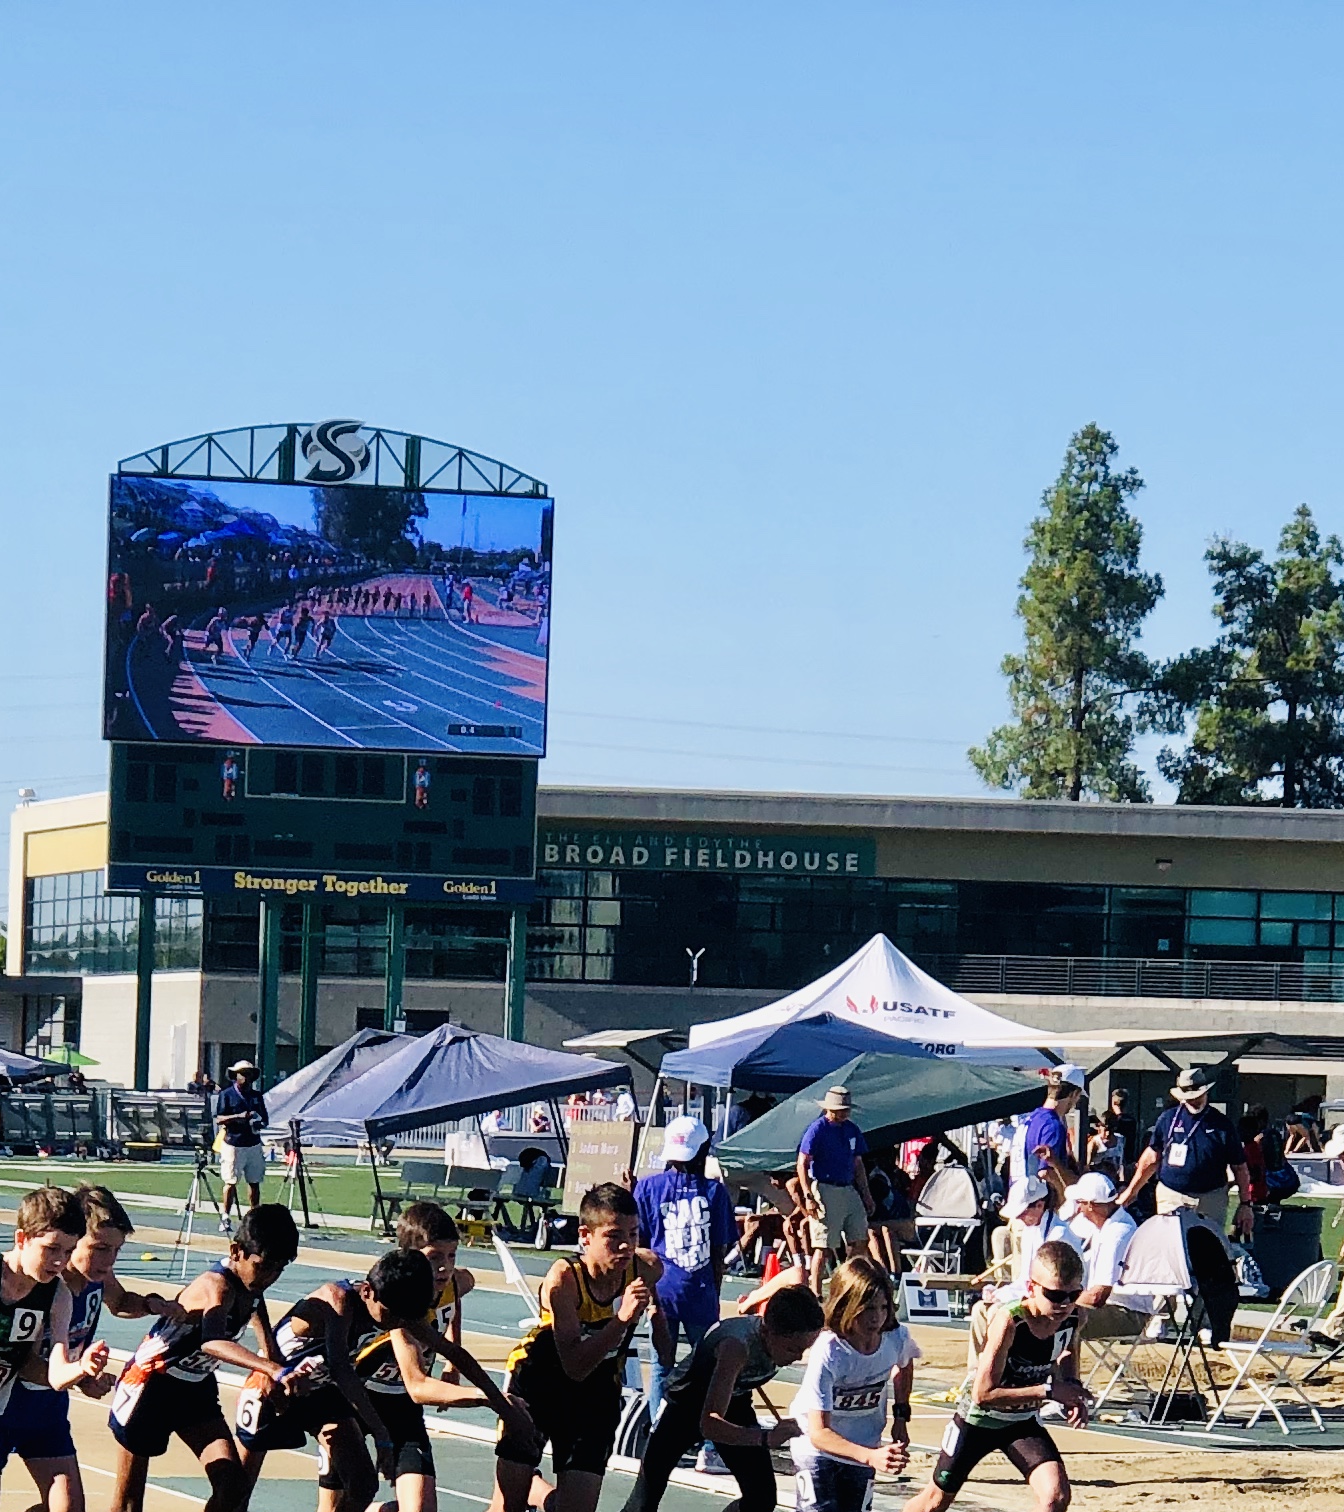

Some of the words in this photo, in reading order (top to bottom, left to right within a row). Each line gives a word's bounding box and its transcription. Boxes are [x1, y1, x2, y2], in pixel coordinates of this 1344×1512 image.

[545, 833, 580, 844] THE
[635, 836, 674, 847] AND
[544, 844, 649, 866] BROAD
[664, 847, 859, 872] FIELDHOUSE
[146, 870, 193, 884] Golden
[234, 871, 318, 894] Stronger
[322, 874, 409, 896] Together
[443, 880, 489, 894] Golden
[882, 1001, 956, 1018] USATF
[16, 1311, 37, 1341] 9
[241, 1399, 254, 1428] 6
